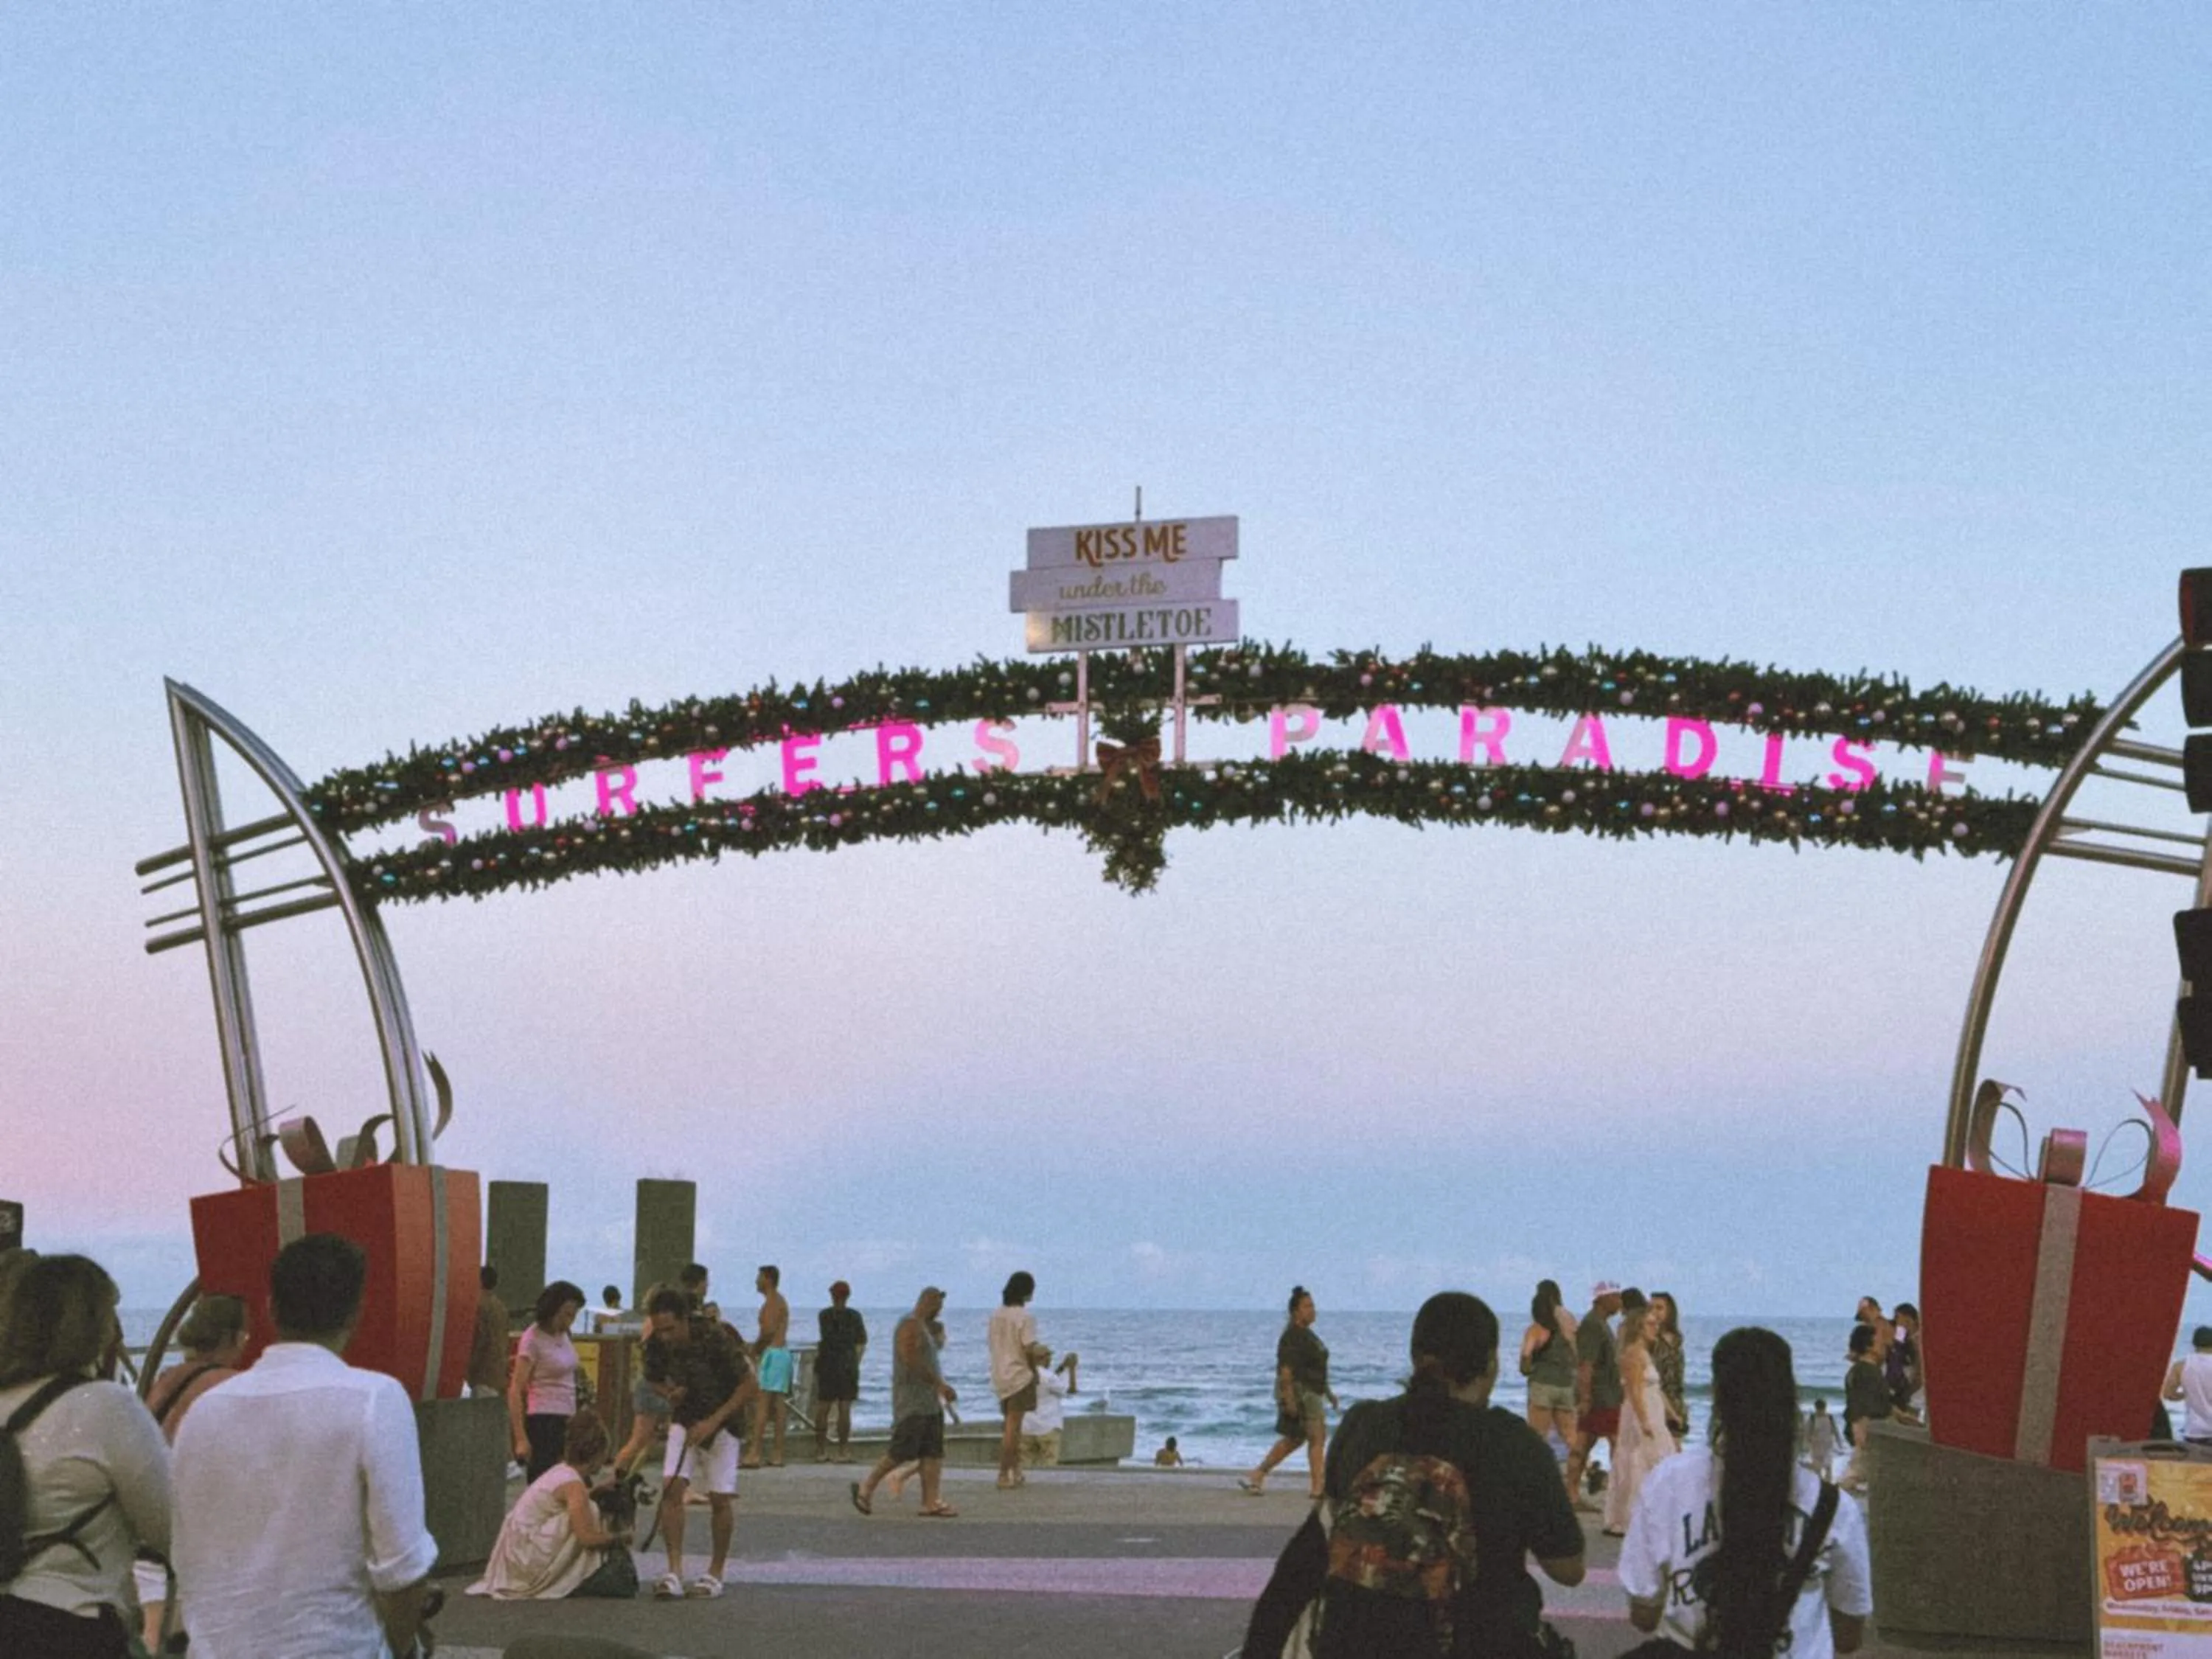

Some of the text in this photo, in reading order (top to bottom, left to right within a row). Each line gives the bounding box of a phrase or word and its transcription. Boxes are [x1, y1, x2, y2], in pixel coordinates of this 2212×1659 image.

[1075, 524, 1187, 568] KISS ME
[1059, 571, 1168, 599] under the
[1051, 608, 1213, 644] MISTLETOE
[418, 702, 1976, 849] SURFERS PARADISE
[2118, 1559, 2169, 1578] WE'RE
